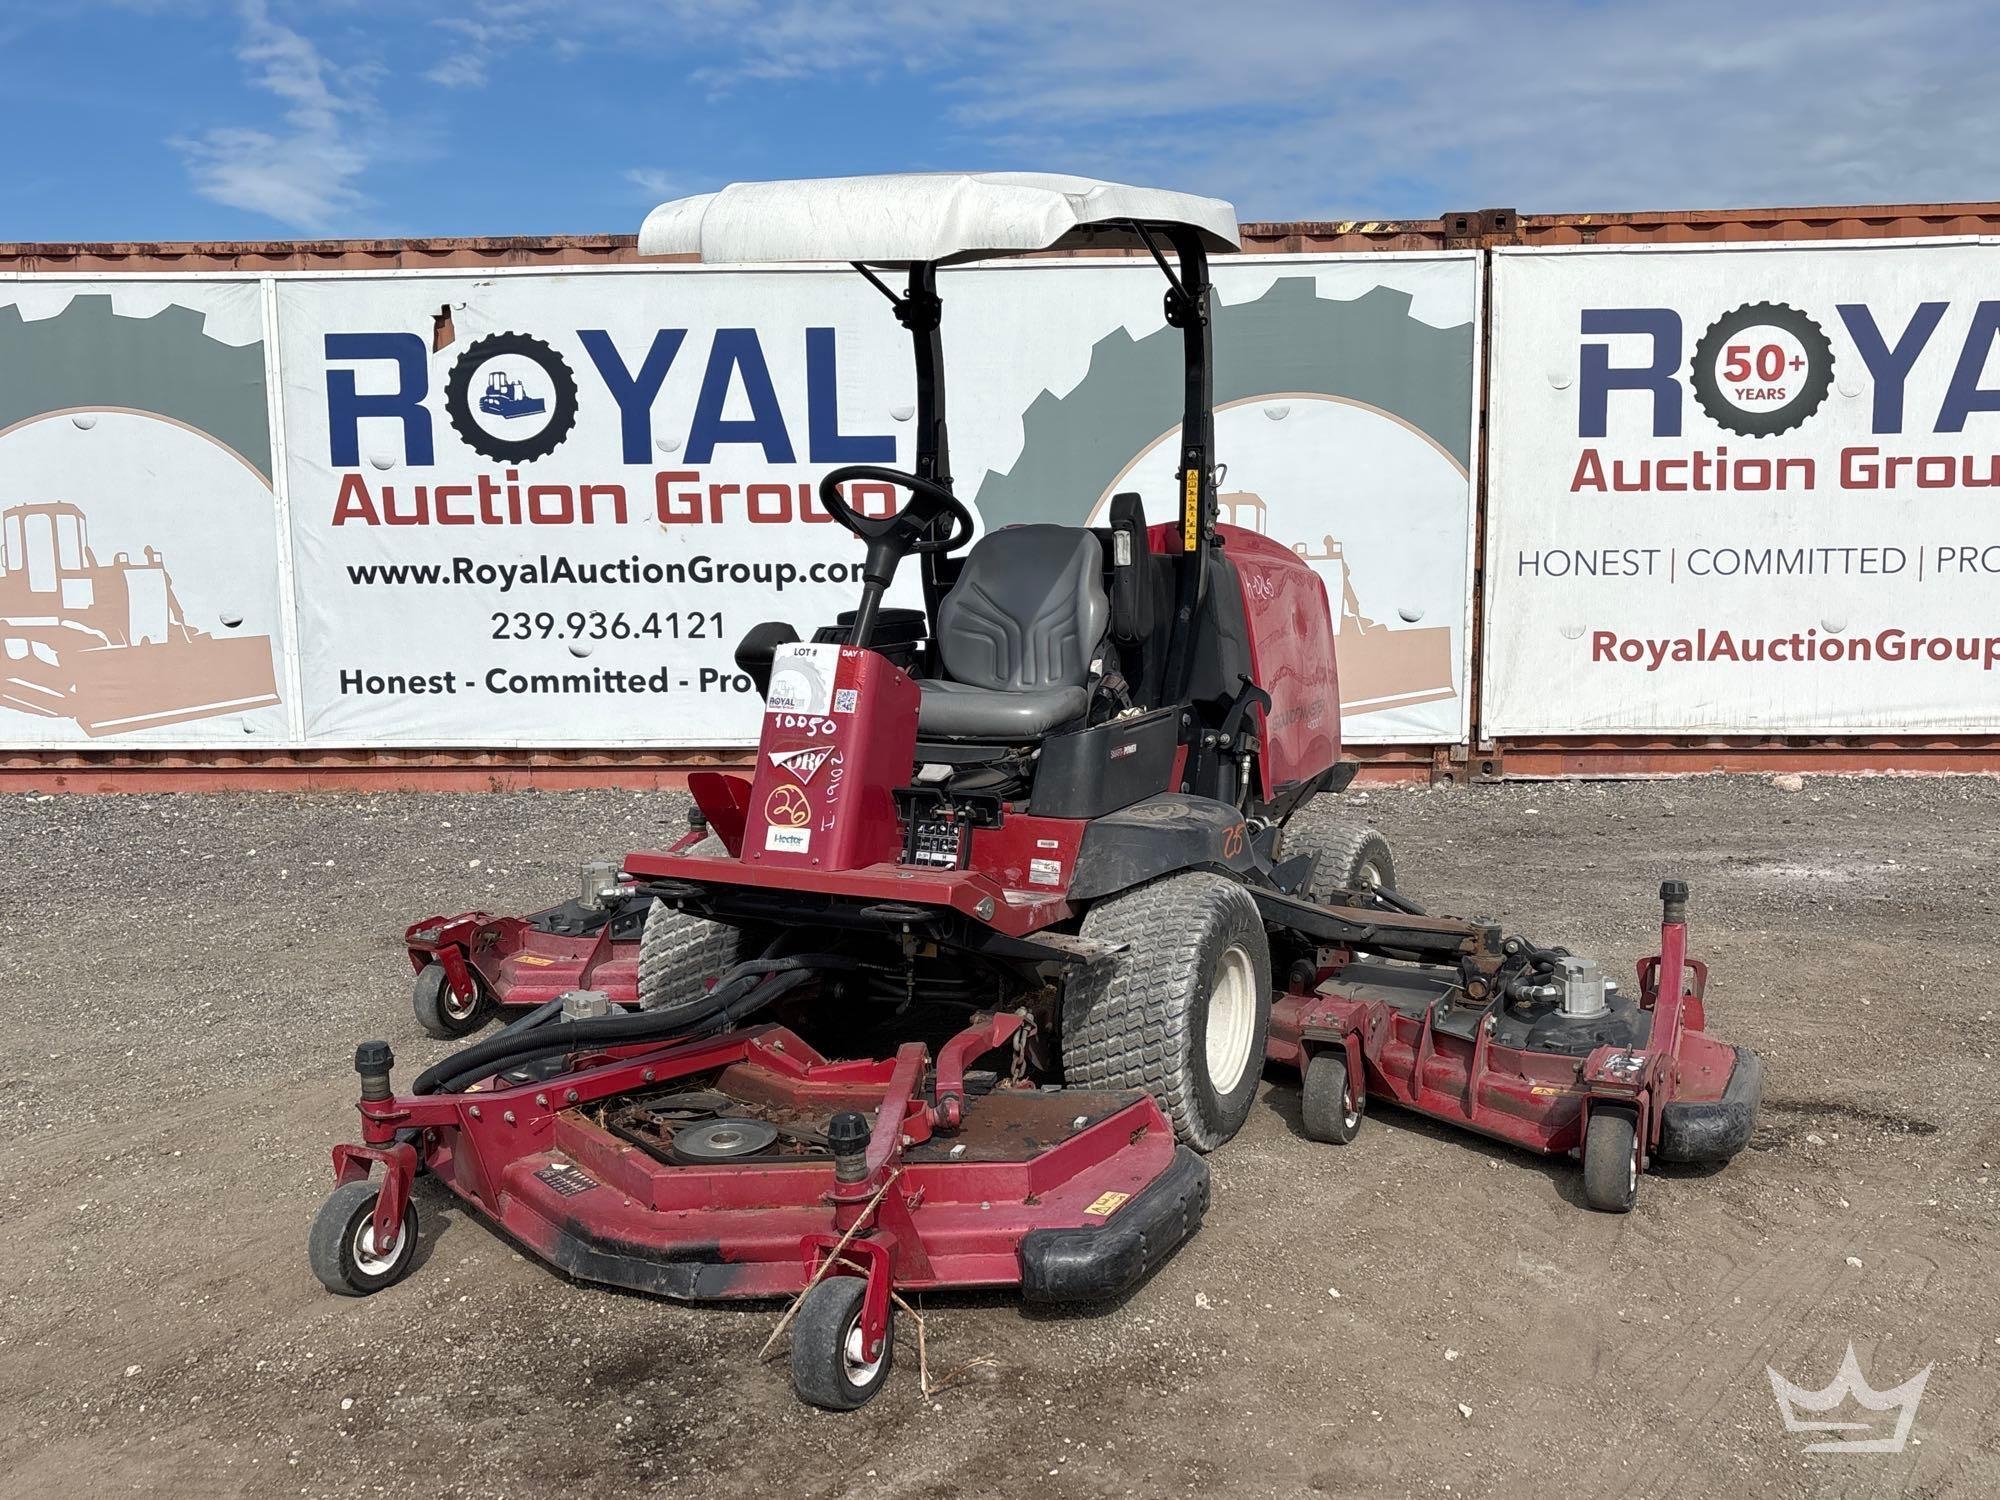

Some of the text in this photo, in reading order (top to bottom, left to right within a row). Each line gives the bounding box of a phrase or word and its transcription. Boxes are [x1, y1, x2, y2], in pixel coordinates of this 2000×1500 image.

[1723, 344, 1806, 383] 50+
[324, 327, 896, 466] ROYAL
[1735, 388, 1786, 401] YEARS
[1570, 446, 2000, 492] Auction Grou
[331, 469, 628, 526] Auction
[1518, 549, 1661, 577] HONEST
[1687, 547, 1907, 576] COMMITTED
[491, 611, 724, 640] 239.936.4121
[794, 648, 811, 658] LOT
[842, 649, 859, 658] DAY
[339, 669, 457, 695] Honest
[485, 666, 669, 694] Committed
[699, 667, 760, 693] Pro
[769, 697, 795, 706] ROYAL
[775, 713, 837, 737] 10050
